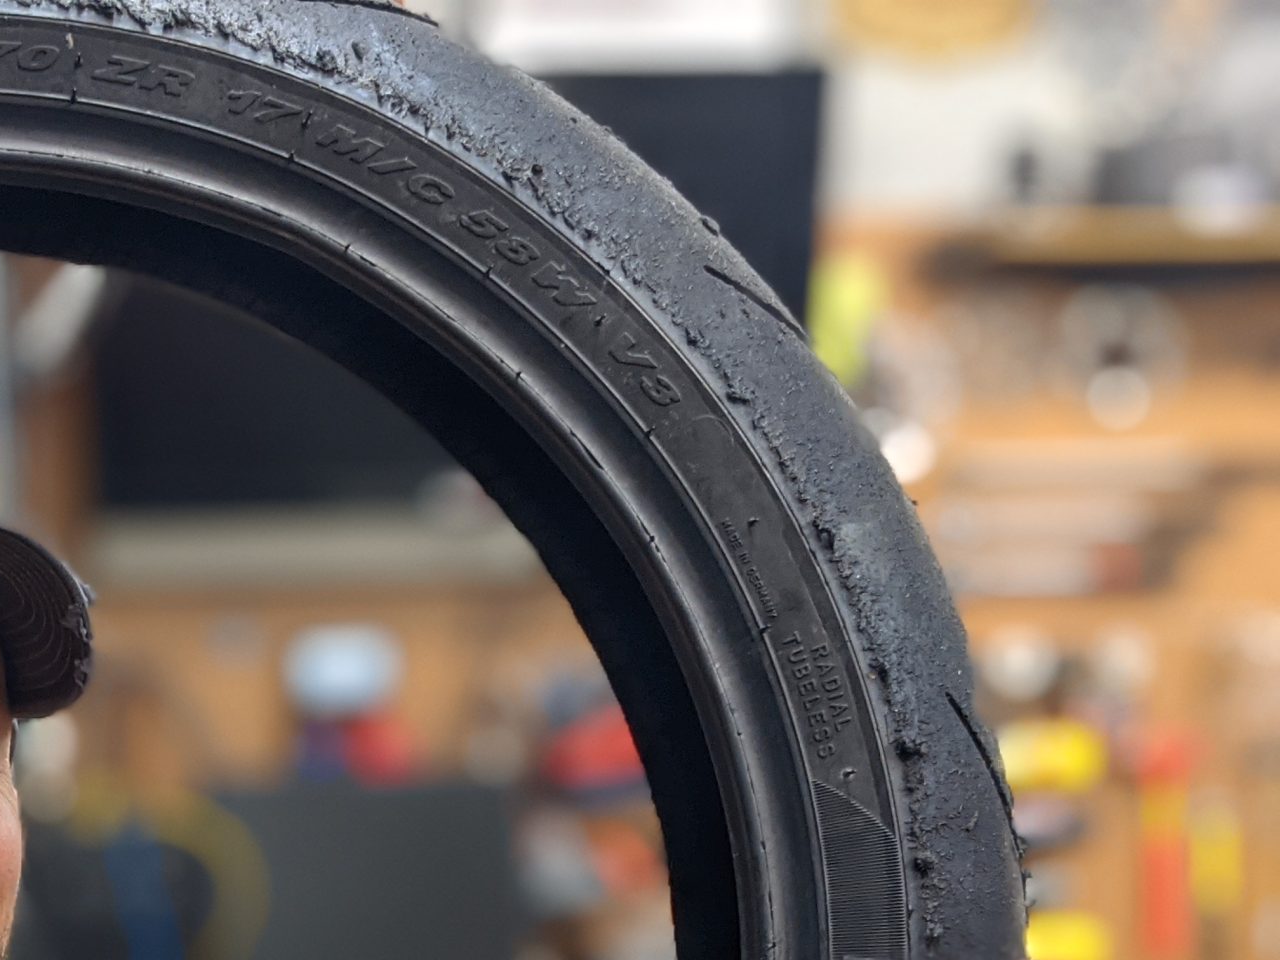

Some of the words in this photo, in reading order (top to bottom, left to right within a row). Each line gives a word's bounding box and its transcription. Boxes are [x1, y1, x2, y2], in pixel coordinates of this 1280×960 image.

[91, 53, 196, 98] ZR
[226, 88, 304, 123] 17
[315, 123, 456, 205] M/C
[781, 630, 836, 760] TUBELESS
[809, 643, 853, 733] RADIAL
